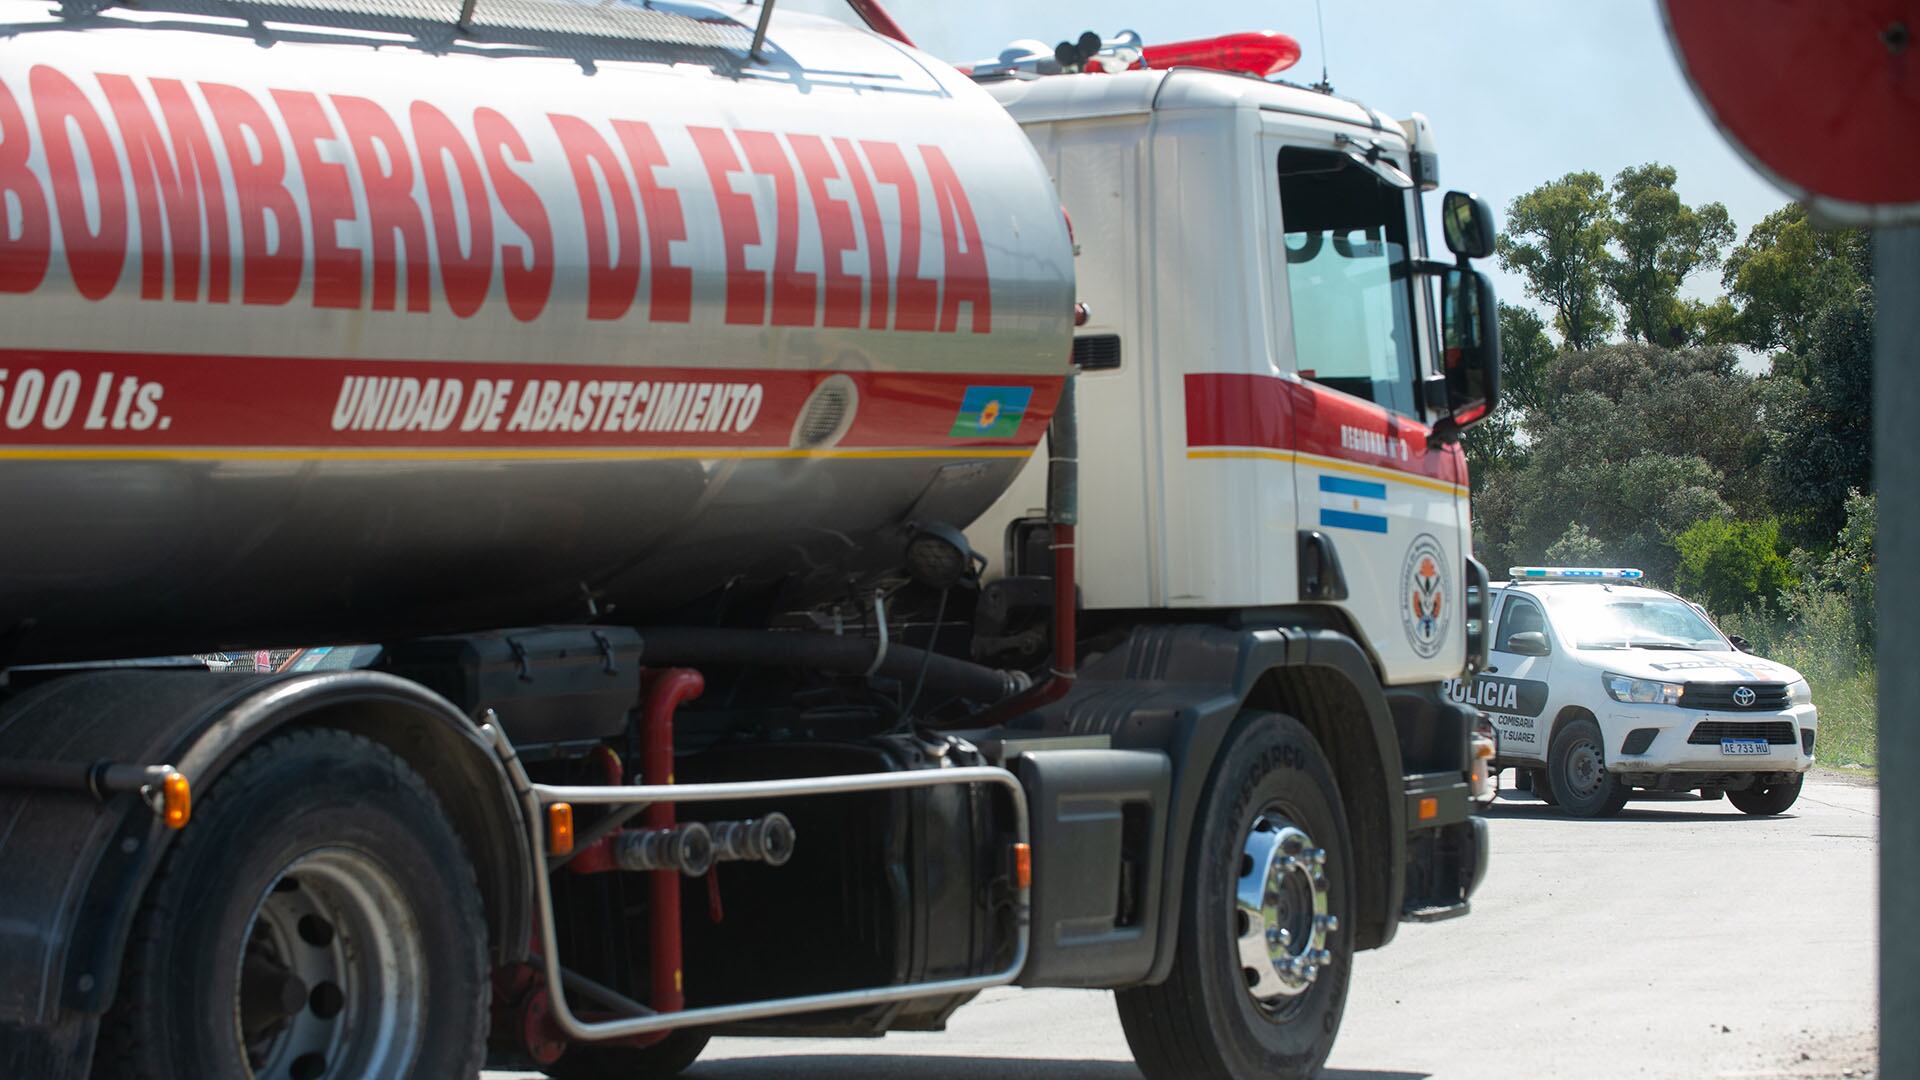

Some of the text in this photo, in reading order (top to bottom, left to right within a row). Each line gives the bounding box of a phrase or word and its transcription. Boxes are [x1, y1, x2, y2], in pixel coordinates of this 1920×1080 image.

[0, 64, 991, 334] BOMBEROS DE EZEIZA
[84, 372, 172, 430] Lts.
[331, 376, 763, 433] UNIDAD DE ABASTECIMIENTO
[1441, 677, 1518, 710] POLICIA
[1498, 715, 1535, 729] COMISARIA
[1724, 743, 1768, 754] AE 733 HU
